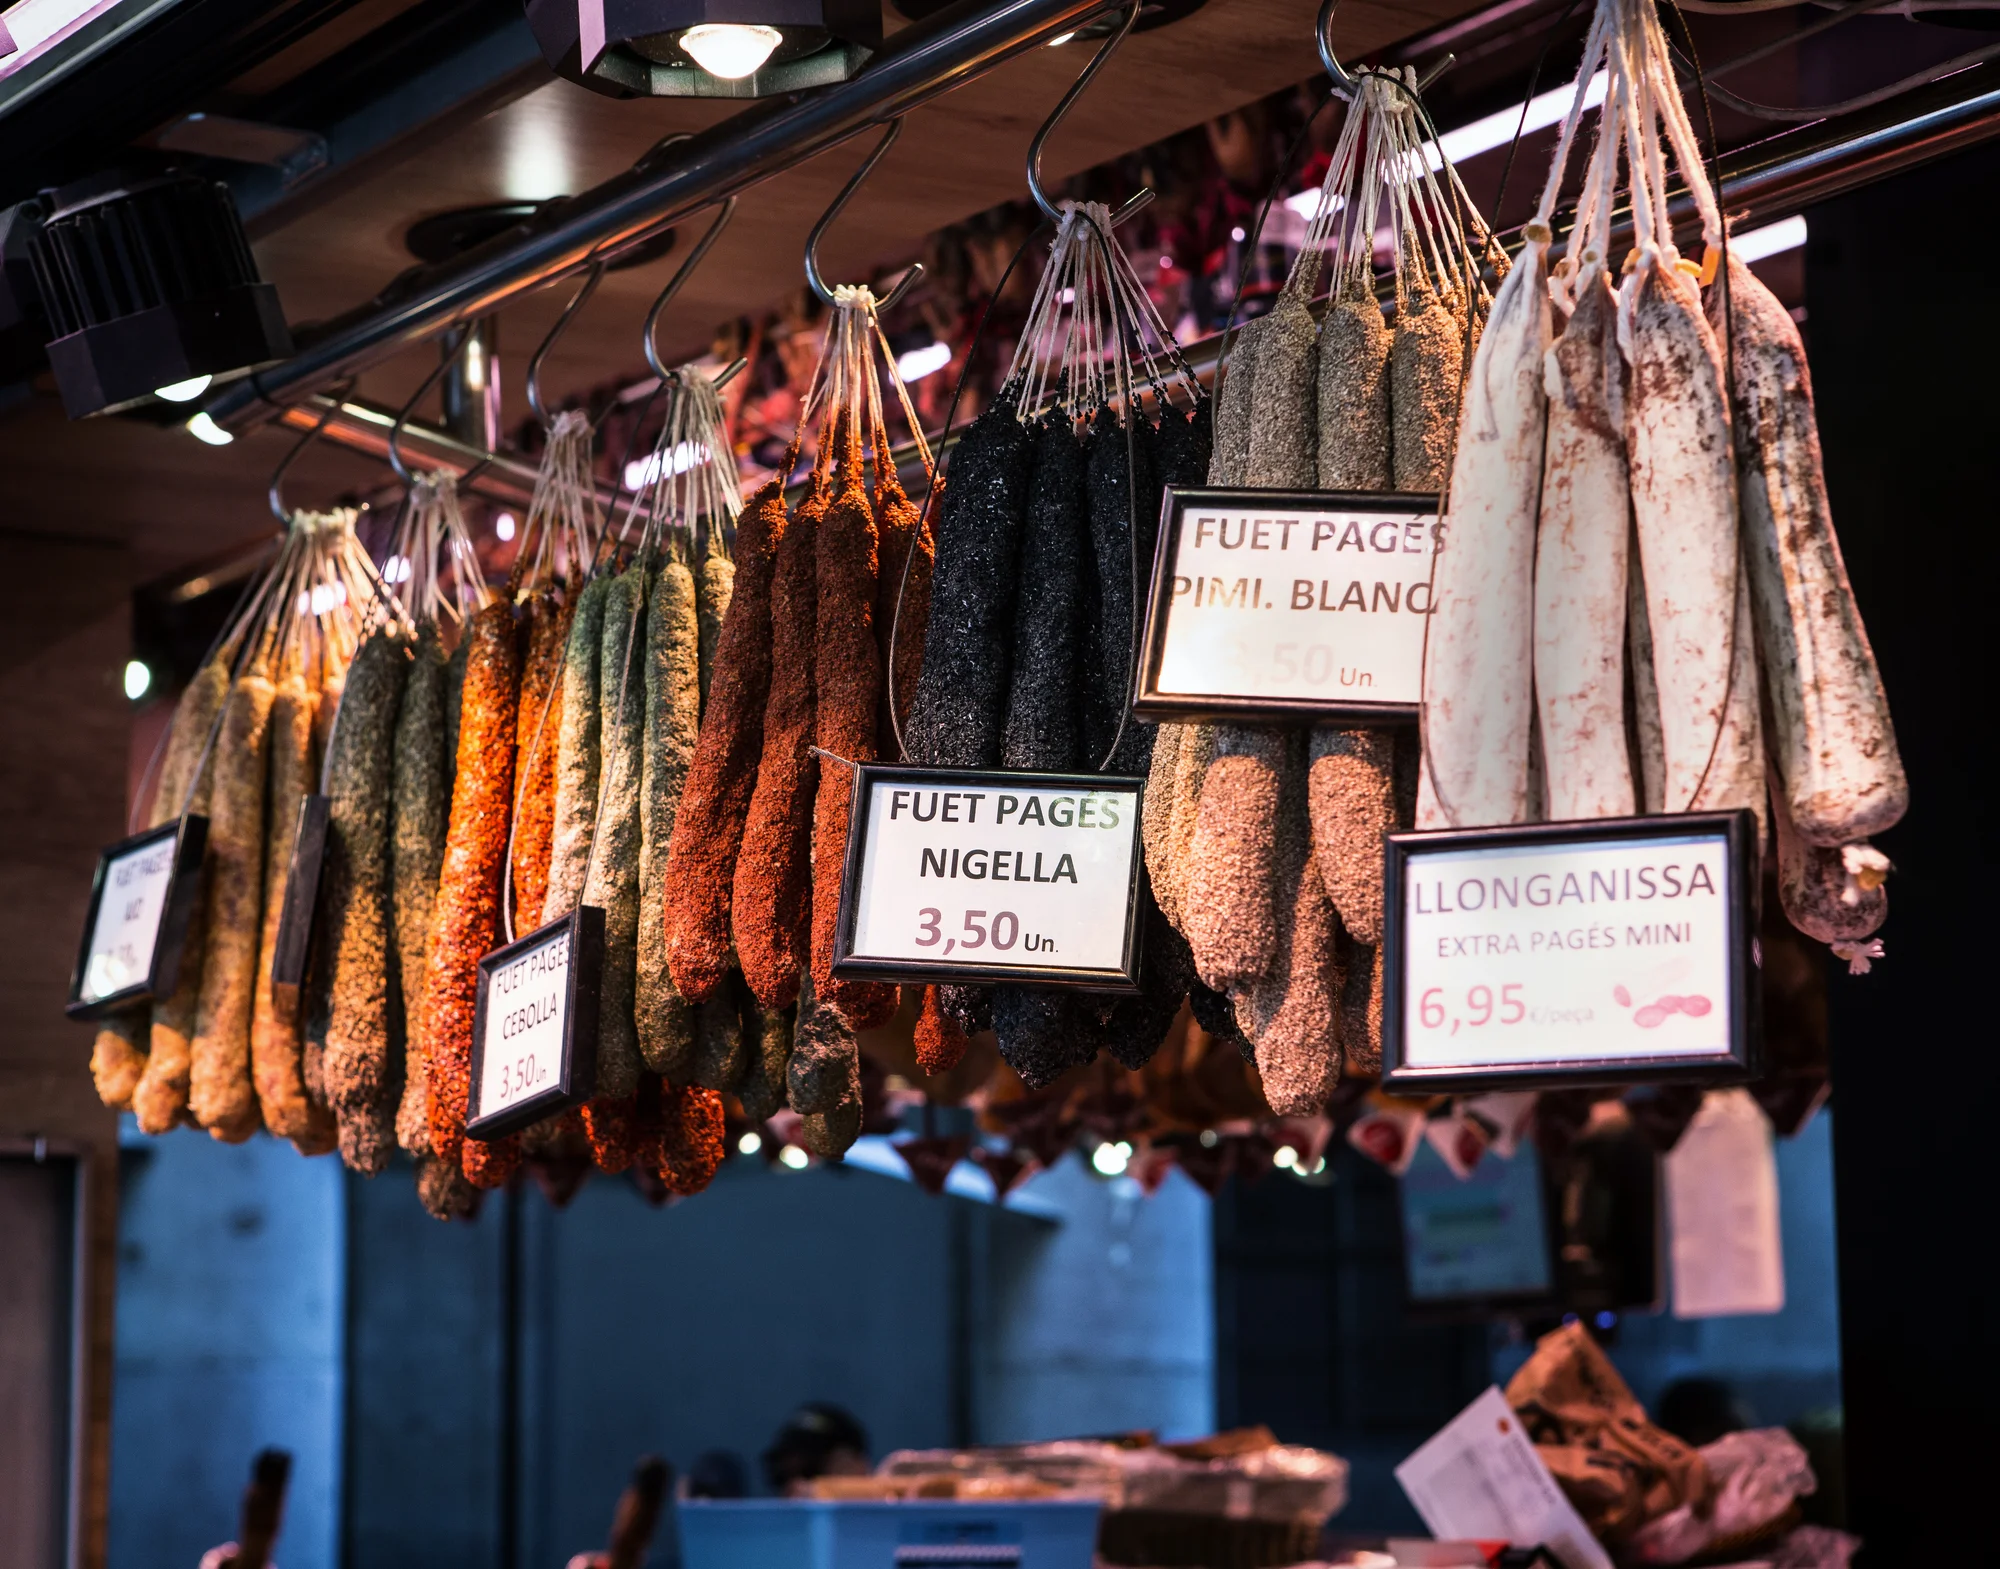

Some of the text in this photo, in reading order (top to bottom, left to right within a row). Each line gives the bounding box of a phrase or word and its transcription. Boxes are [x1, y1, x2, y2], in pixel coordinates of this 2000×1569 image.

[1194, 512, 1449, 555] FUET PAGÉS
[1171, 575, 1440, 615] PIMI. BLANC
[1340, 666, 1378, 688] Un.
[890, 790, 986, 823] FUET
[919, 847, 1079, 884] NIGELLA
[1415, 863, 1716, 914] LLONGANISSA
[915, 907, 1059, 955] 3,50 Un.
[1438, 922, 1692, 958] EXTRA PAGÉS MINI
[496, 960, 528, 998] FUET
[503, 992, 557, 1040] CEBOLLA
[1419, 983, 1526, 1036] 6,95
[500, 1053, 536, 1102] 3,50
